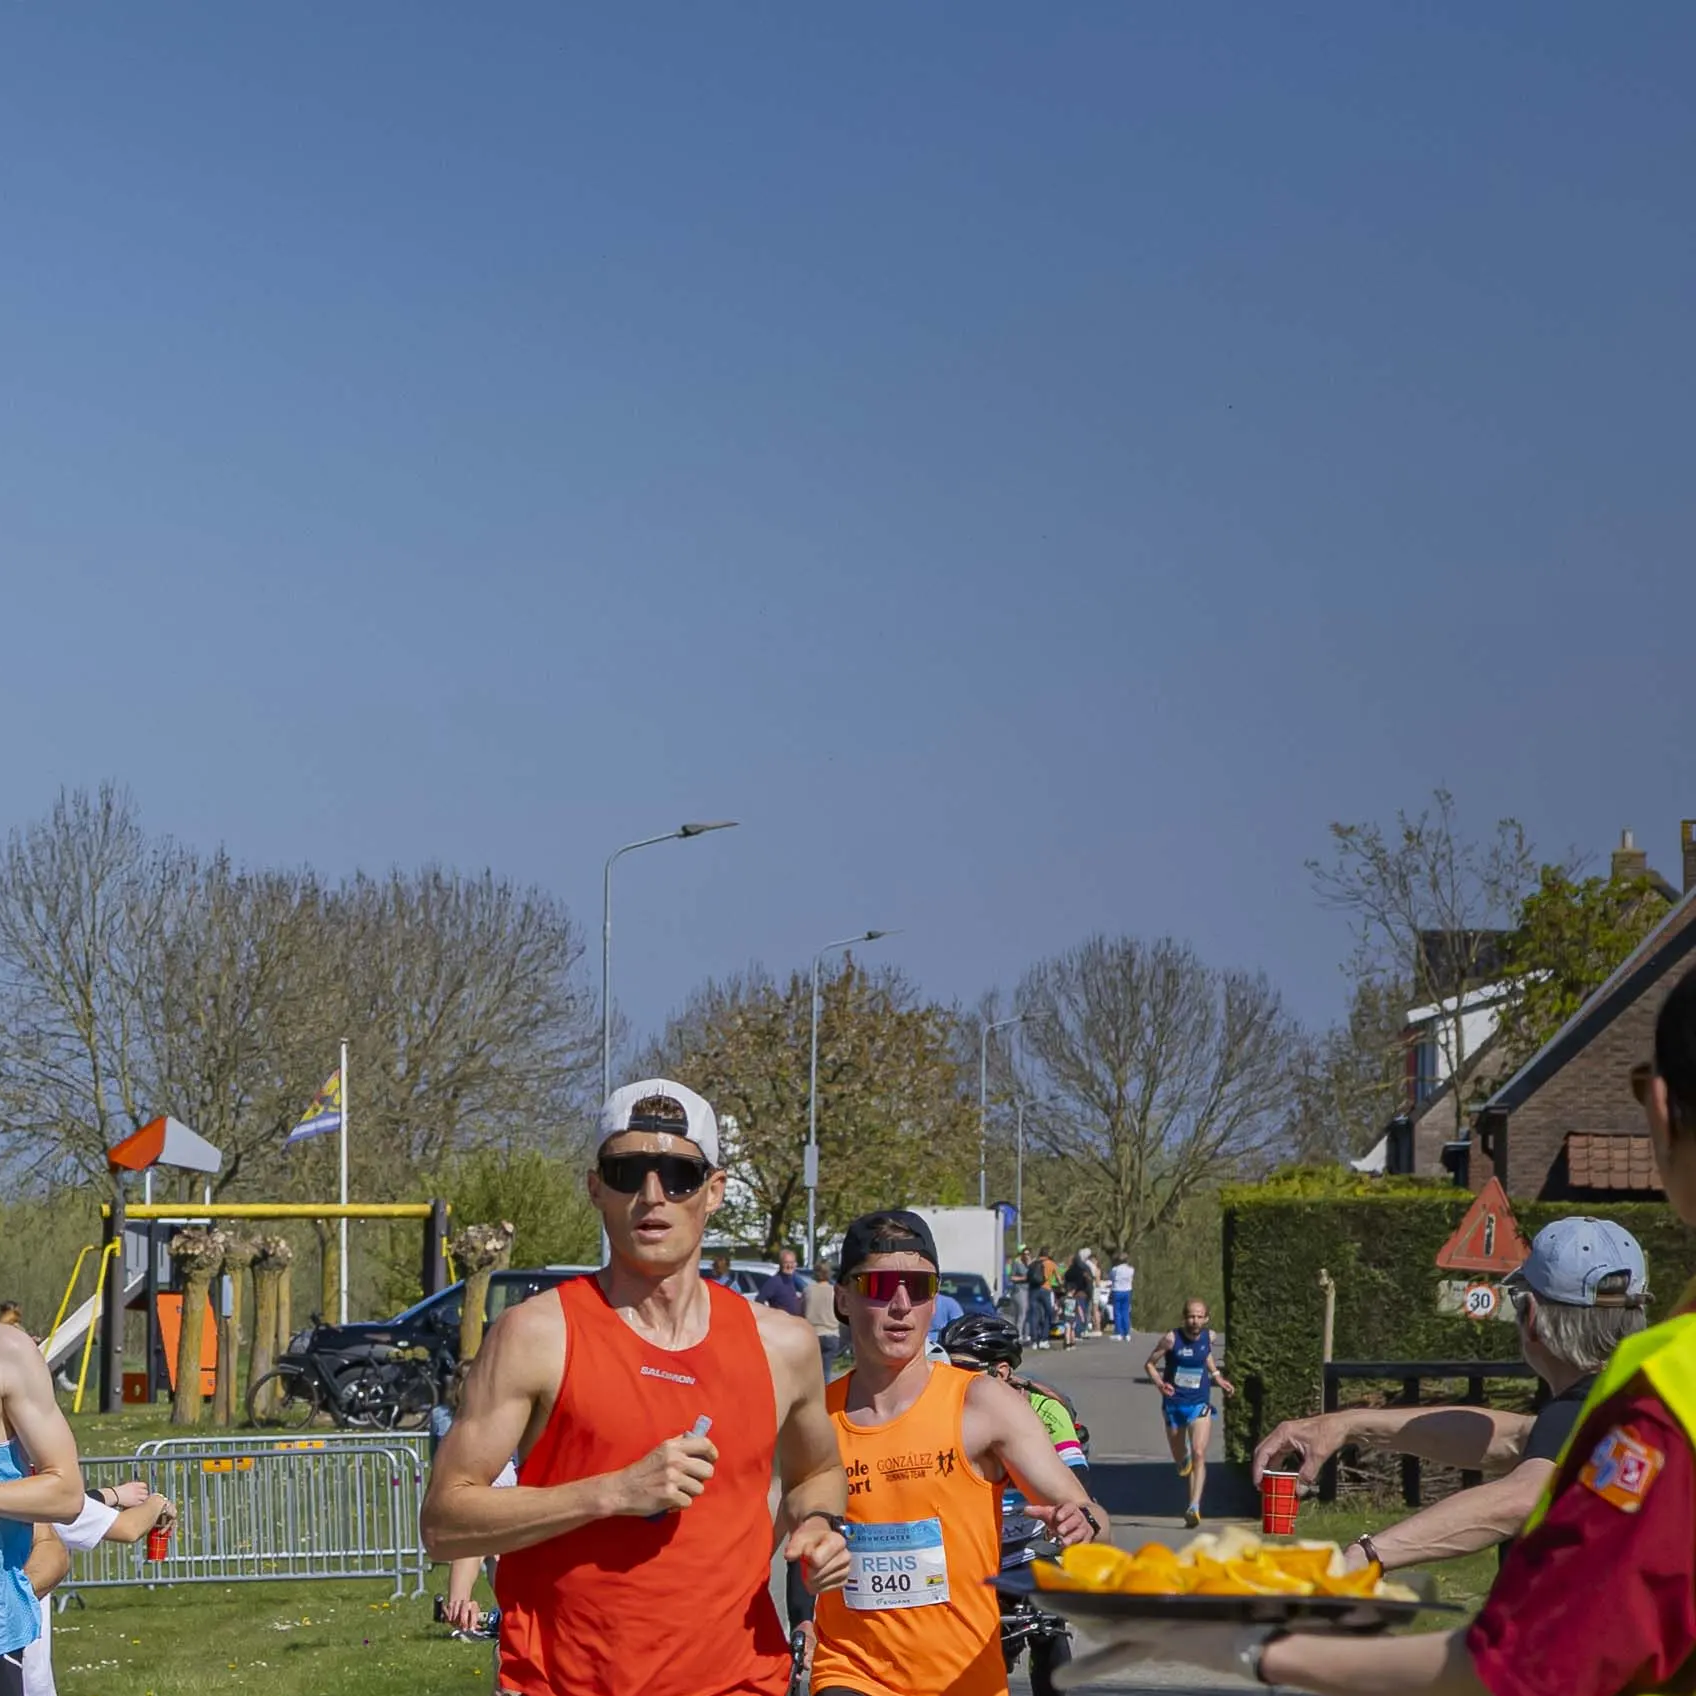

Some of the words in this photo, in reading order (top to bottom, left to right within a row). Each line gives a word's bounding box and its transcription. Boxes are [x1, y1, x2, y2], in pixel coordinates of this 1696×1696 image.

[1470, 1293, 1491, 1311] 30
[640, 1366, 696, 1385] SALOMON
[846, 1459, 869, 1477] ole
[910, 1470, 926, 1479] TEAM
[848, 1478, 872, 1495] ort
[862, 1556, 917, 1572] RENS
[872, 1574, 911, 1593] 840
